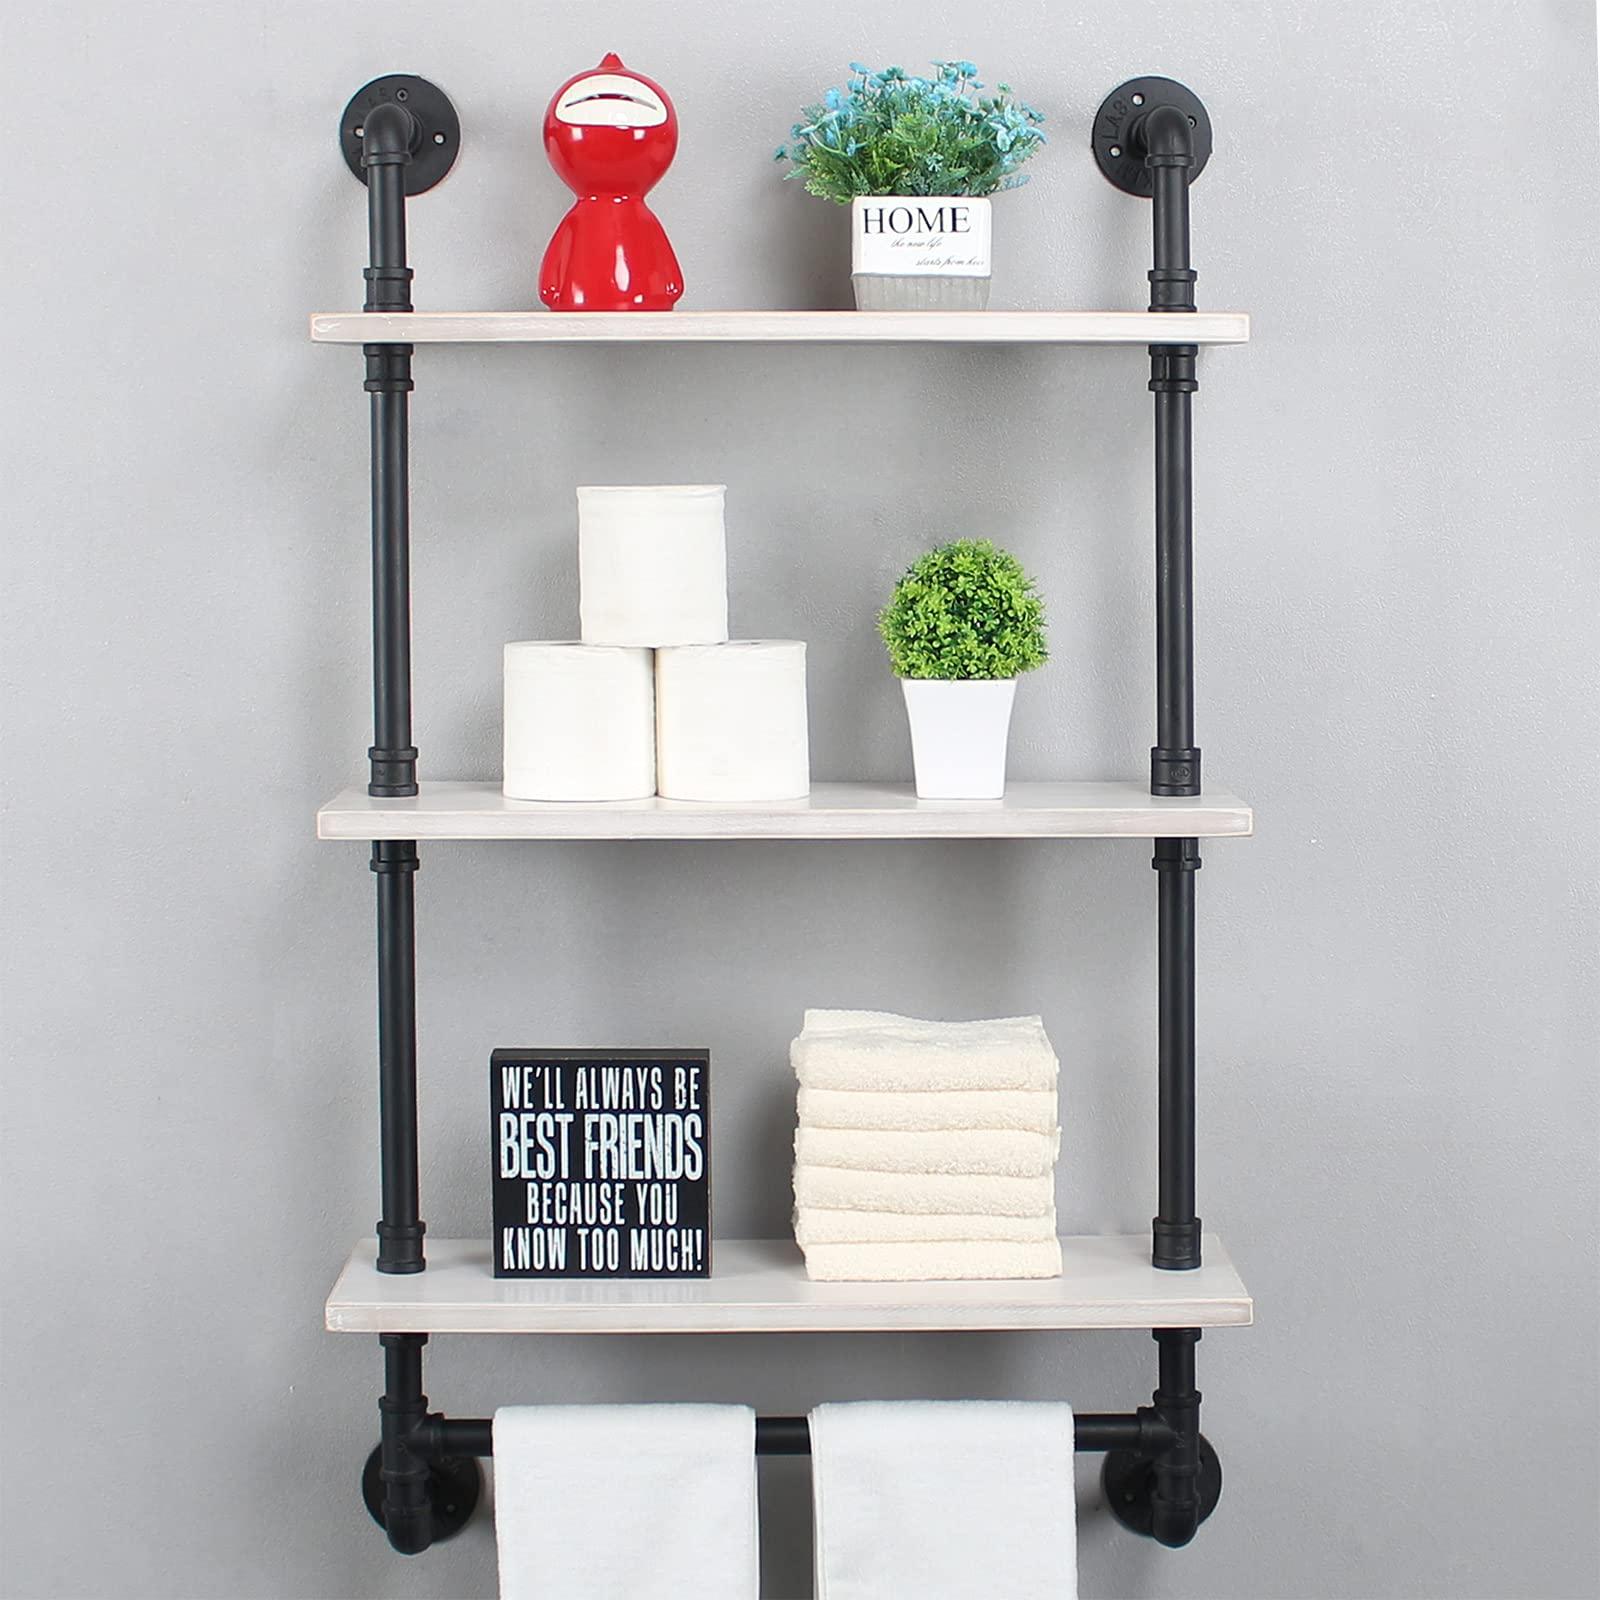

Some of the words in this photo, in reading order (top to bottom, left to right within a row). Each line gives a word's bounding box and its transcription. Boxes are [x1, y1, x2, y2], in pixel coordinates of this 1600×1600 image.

[863, 207, 971, 234] HOME
[890, 237, 905, 248] the
[907, 240, 926, 248] new
[926, 236, 945, 251] life
[915, 256, 942, 266] starts
[939, 255, 965, 269] from
[501, 1066, 565, 1110] WE'LL
[575, 1066, 663, 1110] ALWAYS
[674, 1067, 700, 1110] BE
[500, 1112, 574, 1180] BEST
[584, 1113, 703, 1181] FRIENDS
[527, 1181, 626, 1226] BECAUSE
[636, 1182, 678, 1226] YOU
[503, 1227, 567, 1270] KNOW
[576, 1228, 620, 1271] TOO
[630, 1228, 703, 1272] MUCH!
